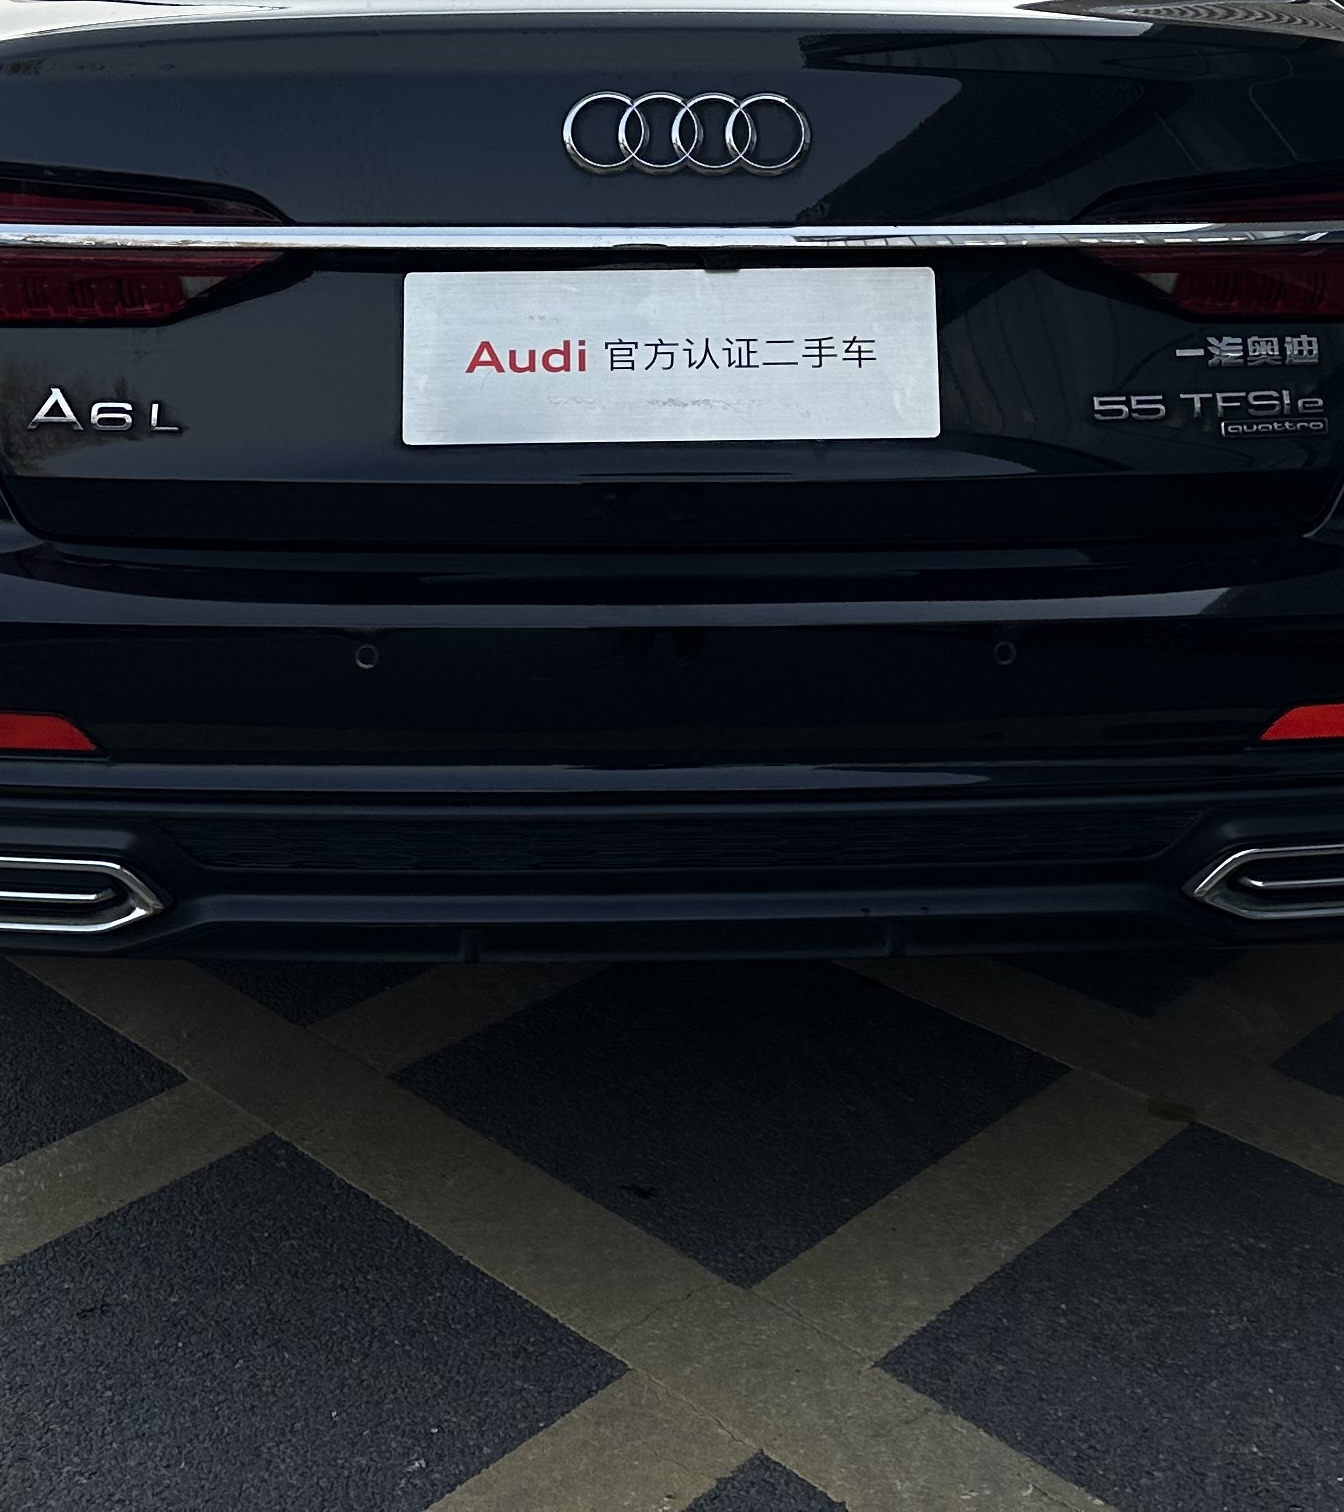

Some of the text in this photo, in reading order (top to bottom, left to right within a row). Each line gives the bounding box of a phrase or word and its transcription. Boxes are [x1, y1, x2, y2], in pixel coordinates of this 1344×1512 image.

[465, 336, 877, 374] Audi 官方认证二手车
[1175, 335, 1320, 368] 一汽奥迪
[1092, 395, 1167, 420] 55
[1227, 420, 1324, 434] quattro
